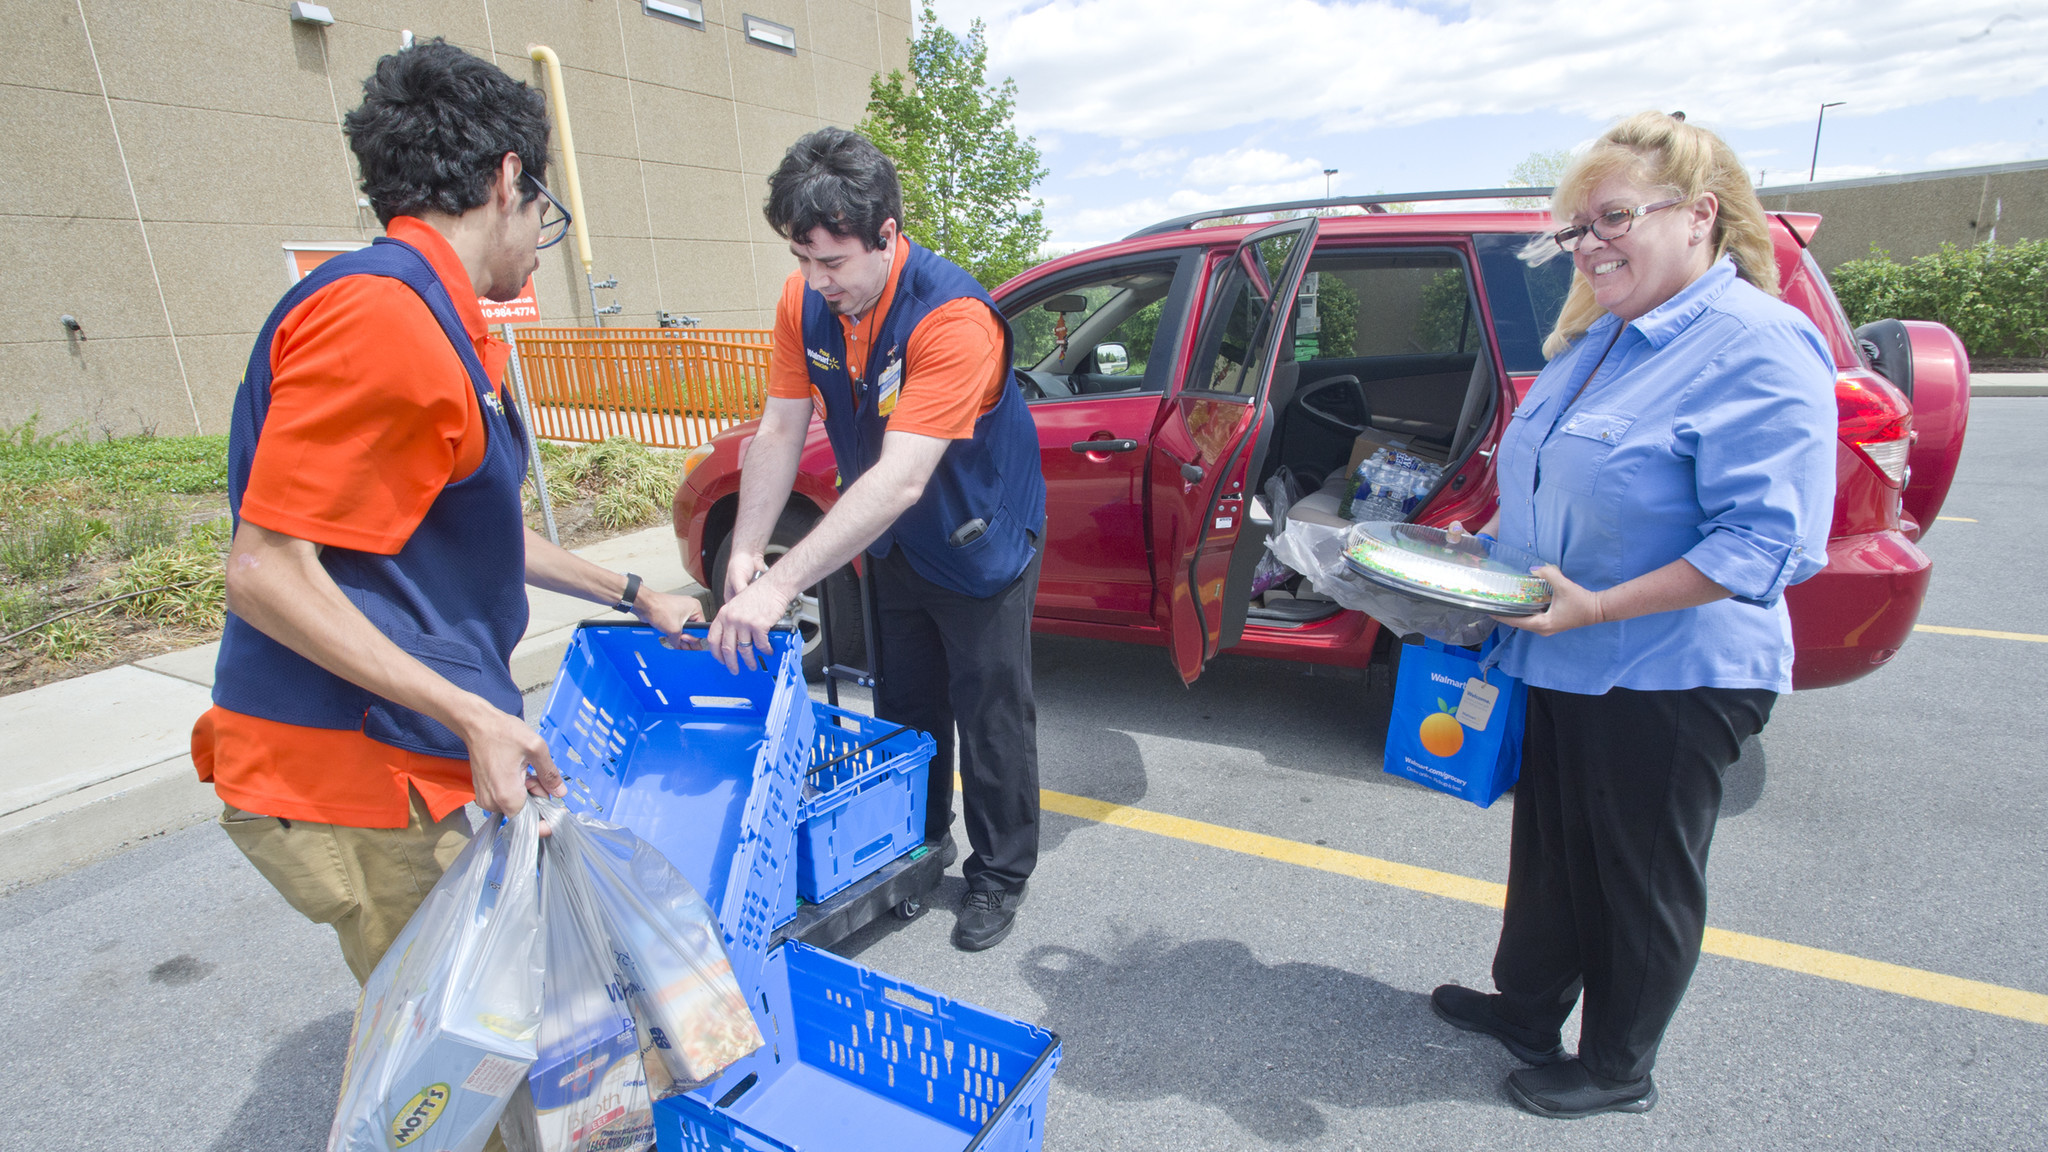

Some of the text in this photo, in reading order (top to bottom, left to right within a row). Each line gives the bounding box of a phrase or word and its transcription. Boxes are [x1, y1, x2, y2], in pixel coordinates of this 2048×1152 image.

[481, 306, 536, 318] 10-984-4774
[807, 347, 829, 365] Walmart
[1431, 672, 1467, 690] Walmart
[590, 1114, 609, 1130] EEF
